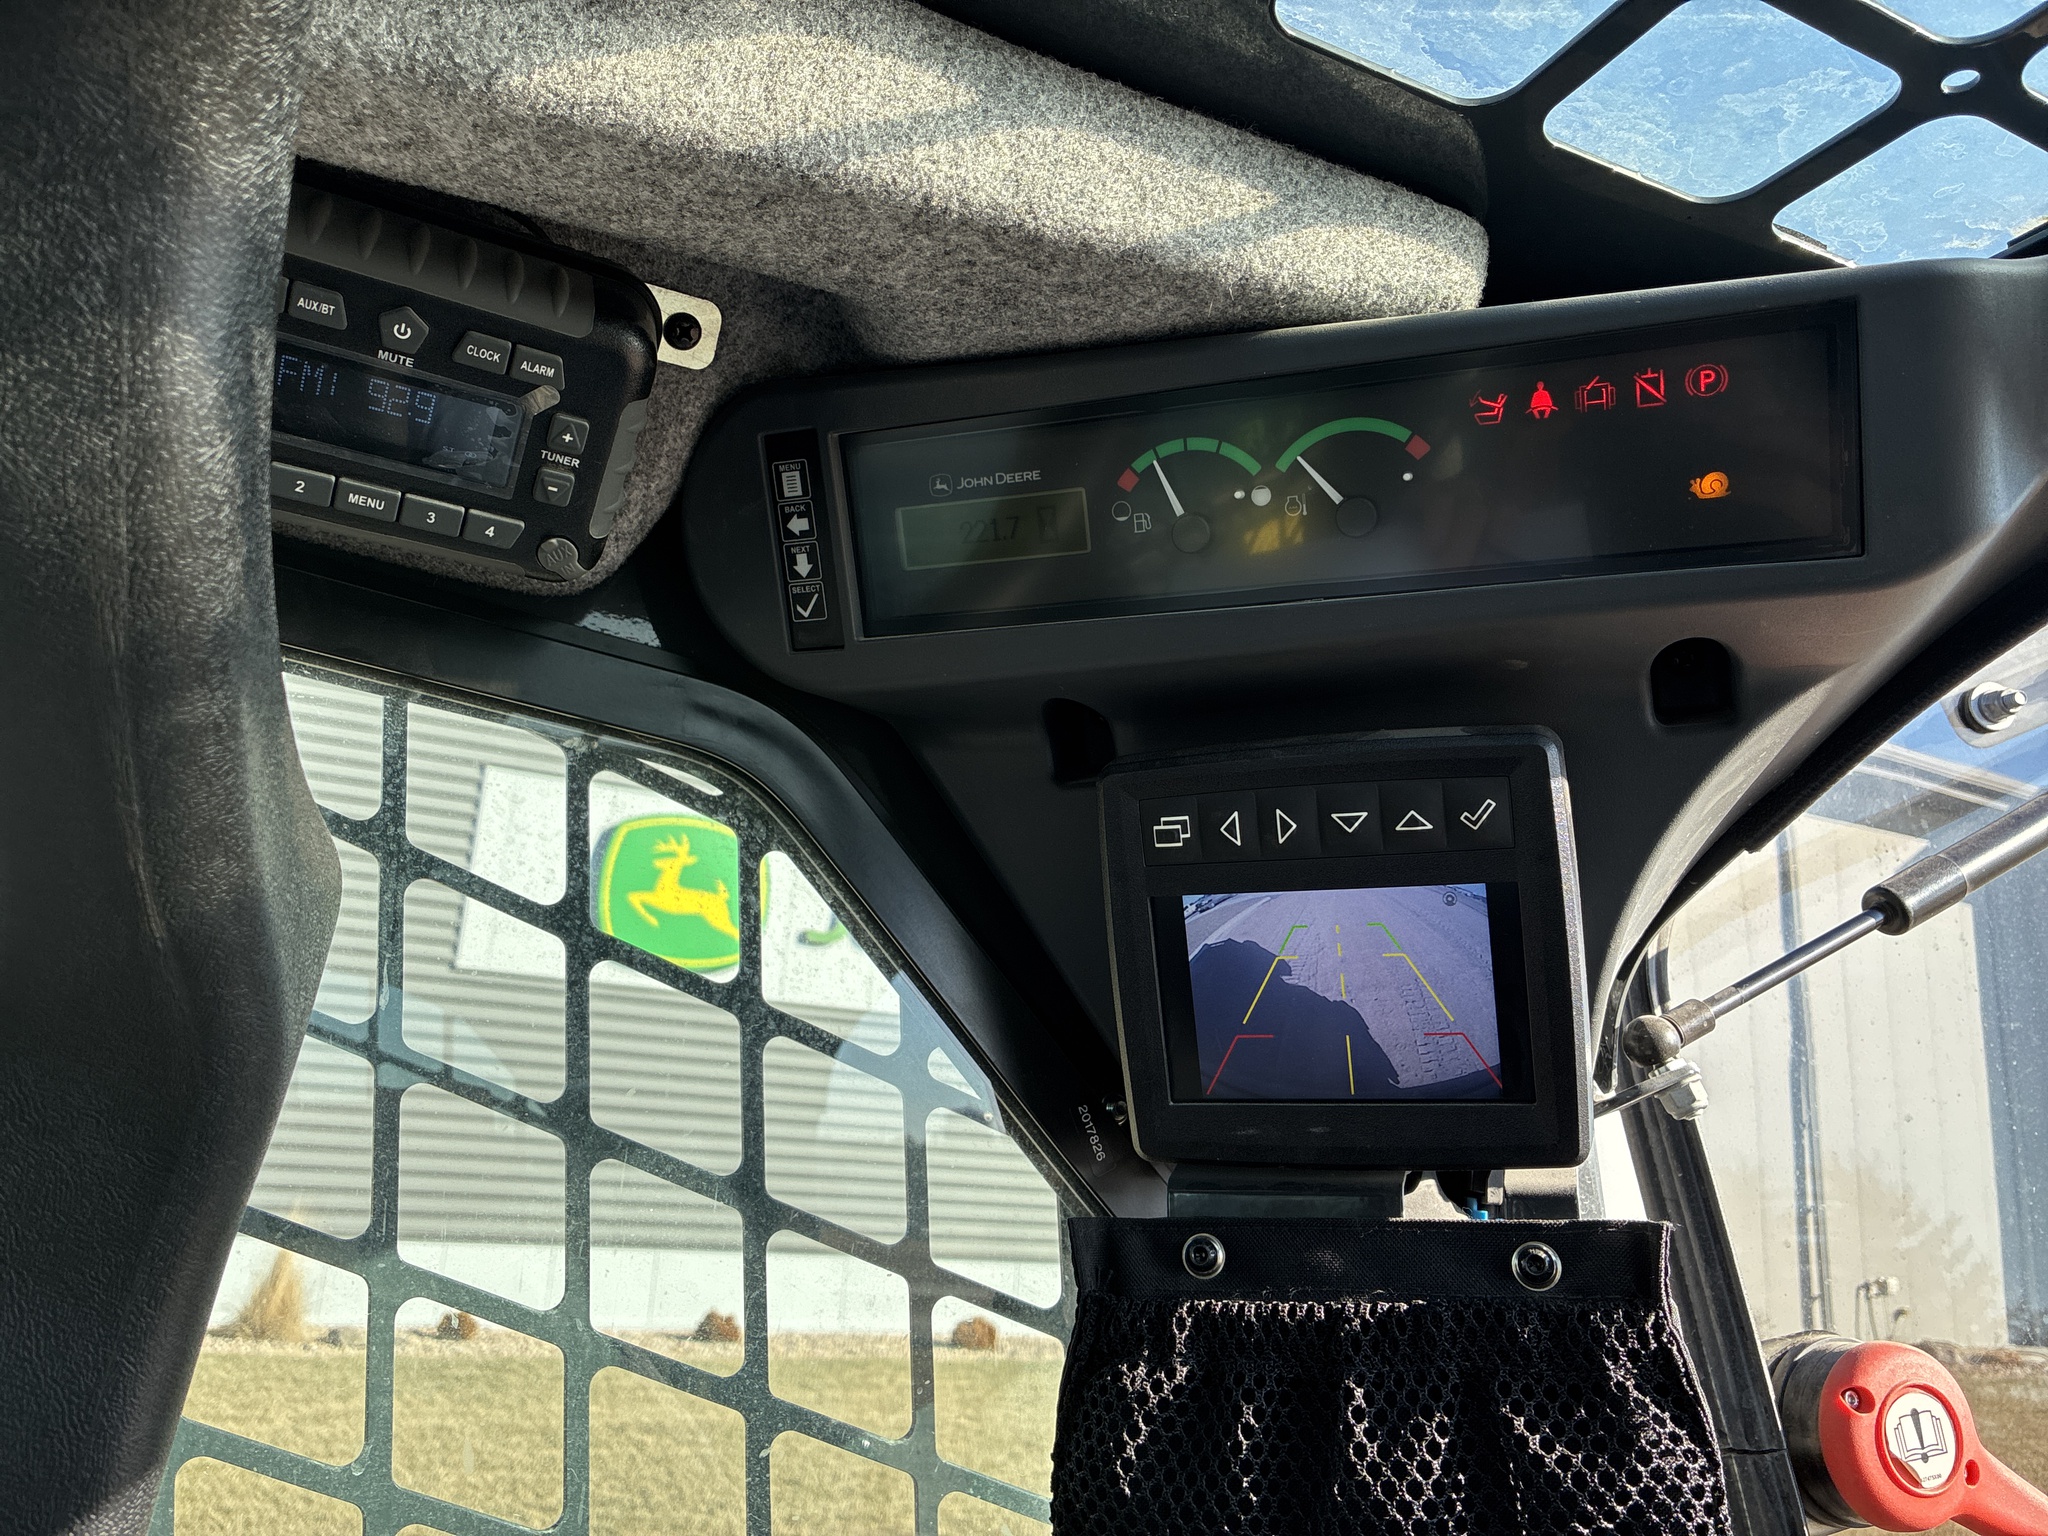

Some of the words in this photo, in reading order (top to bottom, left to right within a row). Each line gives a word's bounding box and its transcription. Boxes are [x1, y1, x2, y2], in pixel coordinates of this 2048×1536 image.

[297, 297, 336, 316] AUX/BT
[377, 349, 415, 368] MUTE
[466, 344, 502, 363] CLOCK
[520, 360, 556, 378] ALARM
[1699, 369, 1716, 392] P
[368, 378, 437, 424] 92.9
[540, 449, 580, 469] TUNER
[778, 462, 801, 472] MENU
[294, 480, 305, 493] 2
[956, 476, 993, 490] JOHN
[995, 470, 1042, 485] DEERE
[347, 492, 386, 511] MENU
[784, 504, 807, 514] BACK
[426, 511, 436, 524] 3
[484, 526, 495, 538] 4
[545, 544, 573, 568] AUX
[790, 545, 811, 554] NEXT
[560, 562, 576, 576] IN
[791, 584, 821, 594] SELECT
[1077, 1104, 1106, 1162] 2017826
